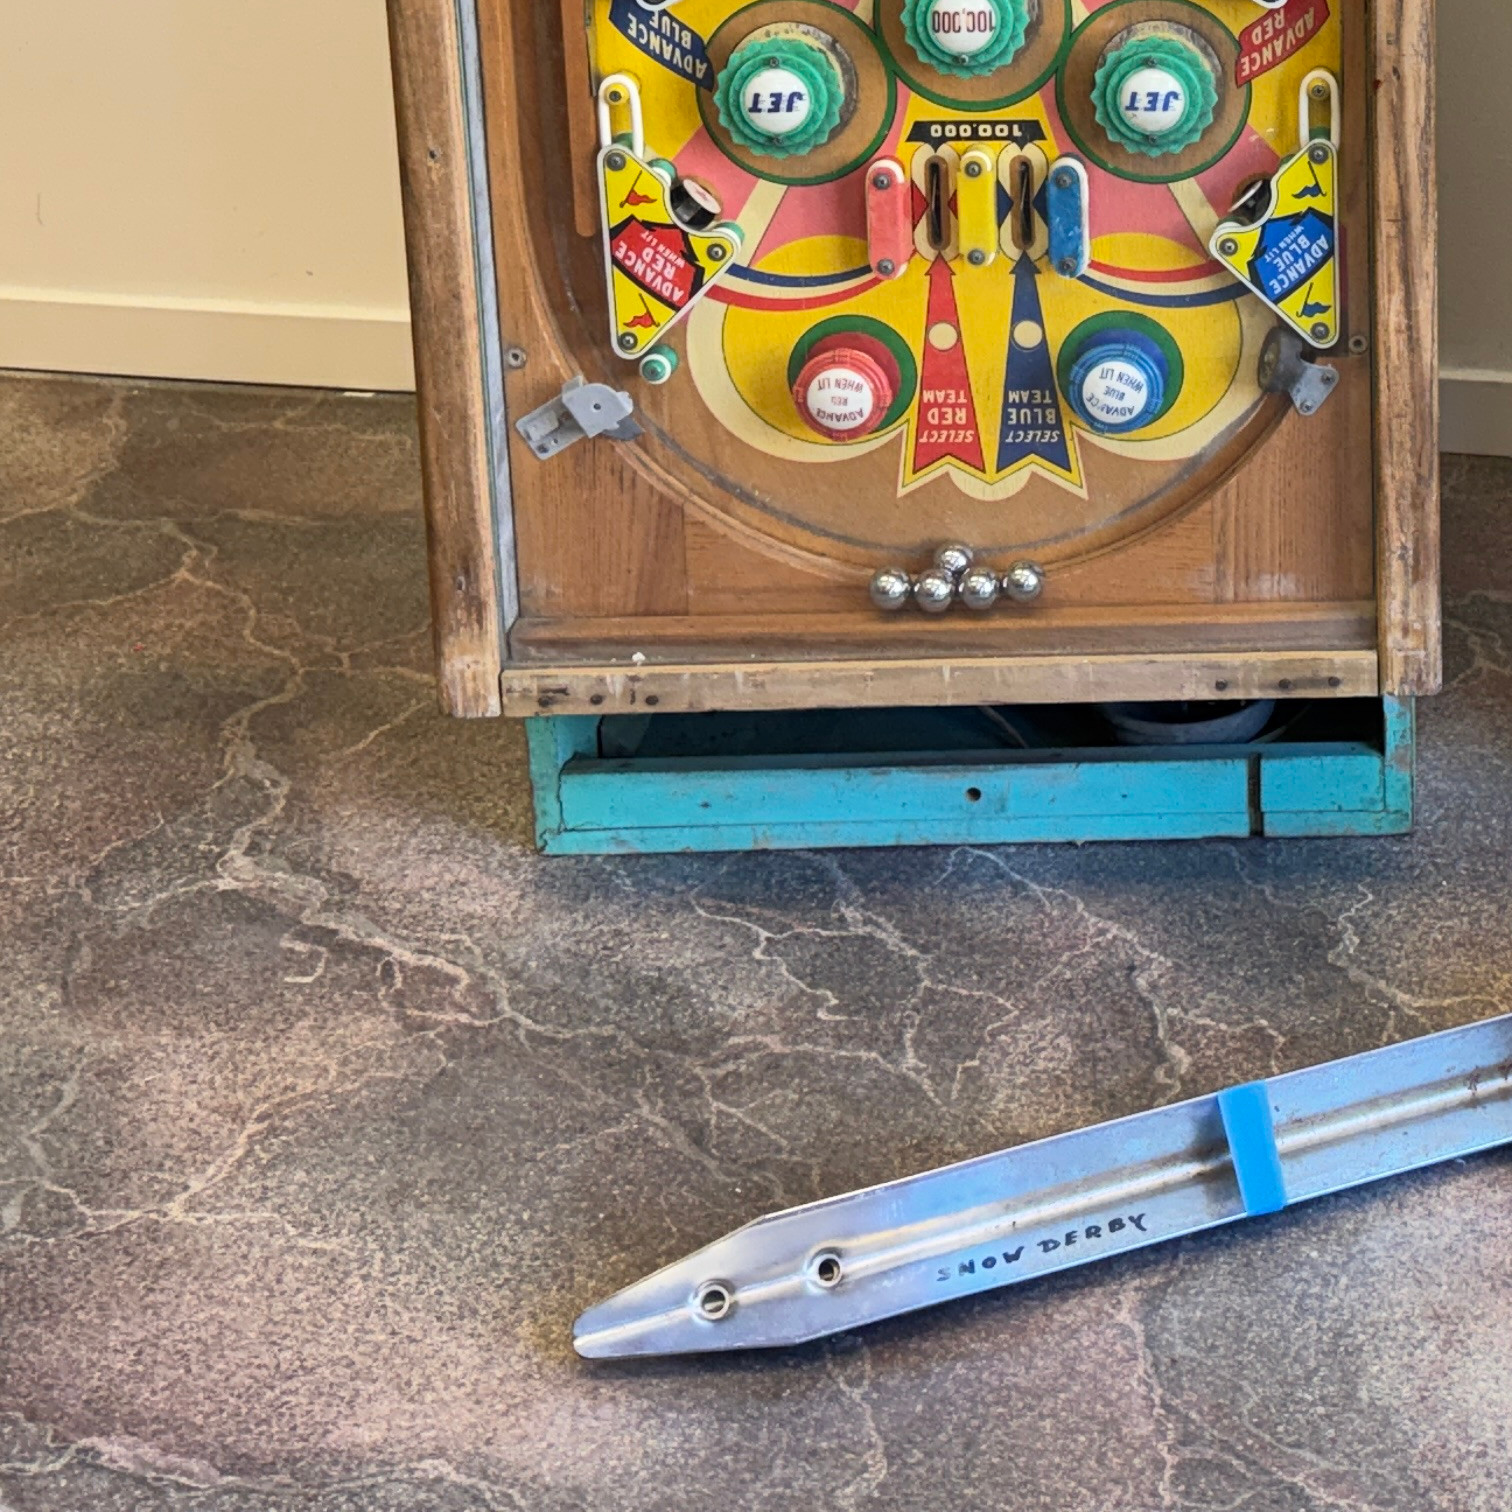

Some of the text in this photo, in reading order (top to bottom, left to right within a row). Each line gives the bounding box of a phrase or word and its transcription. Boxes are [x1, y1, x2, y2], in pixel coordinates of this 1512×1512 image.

[649, 11, 692, 47] BLUE
[1240, 8, 1315, 77] ADVANCE
[1252, 10, 1285, 44] RED
[627, 13, 707, 79] ADVANCE
[748, 92, 805, 113] JET
[1125, 91, 1180, 112] JET
[640, 230, 685, 268] WHEN LIT
[1263, 224, 1304, 262] WHEN LIT
[1272, 236, 1310, 272] BLUE
[615, 240, 684, 301] ADVANCE
[642, 246, 675, 277] RED
[1269, 233, 1329, 294] ADVANCE
[817, 377, 864, 393] WHEN LIT
[1099, 367, 1143, 393] WHEN LIT
[923, 390, 967, 402] TEAM
[1008, 390, 1052, 403] TEAM
[928, 408, 966, 424] RED
[1007, 408, 1055, 424] BLUE
[920, 430, 974, 442] SELECT
[1005, 430, 1060, 442] SELECT
[936, 1212, 1147, 1282] SNOW DERBY
